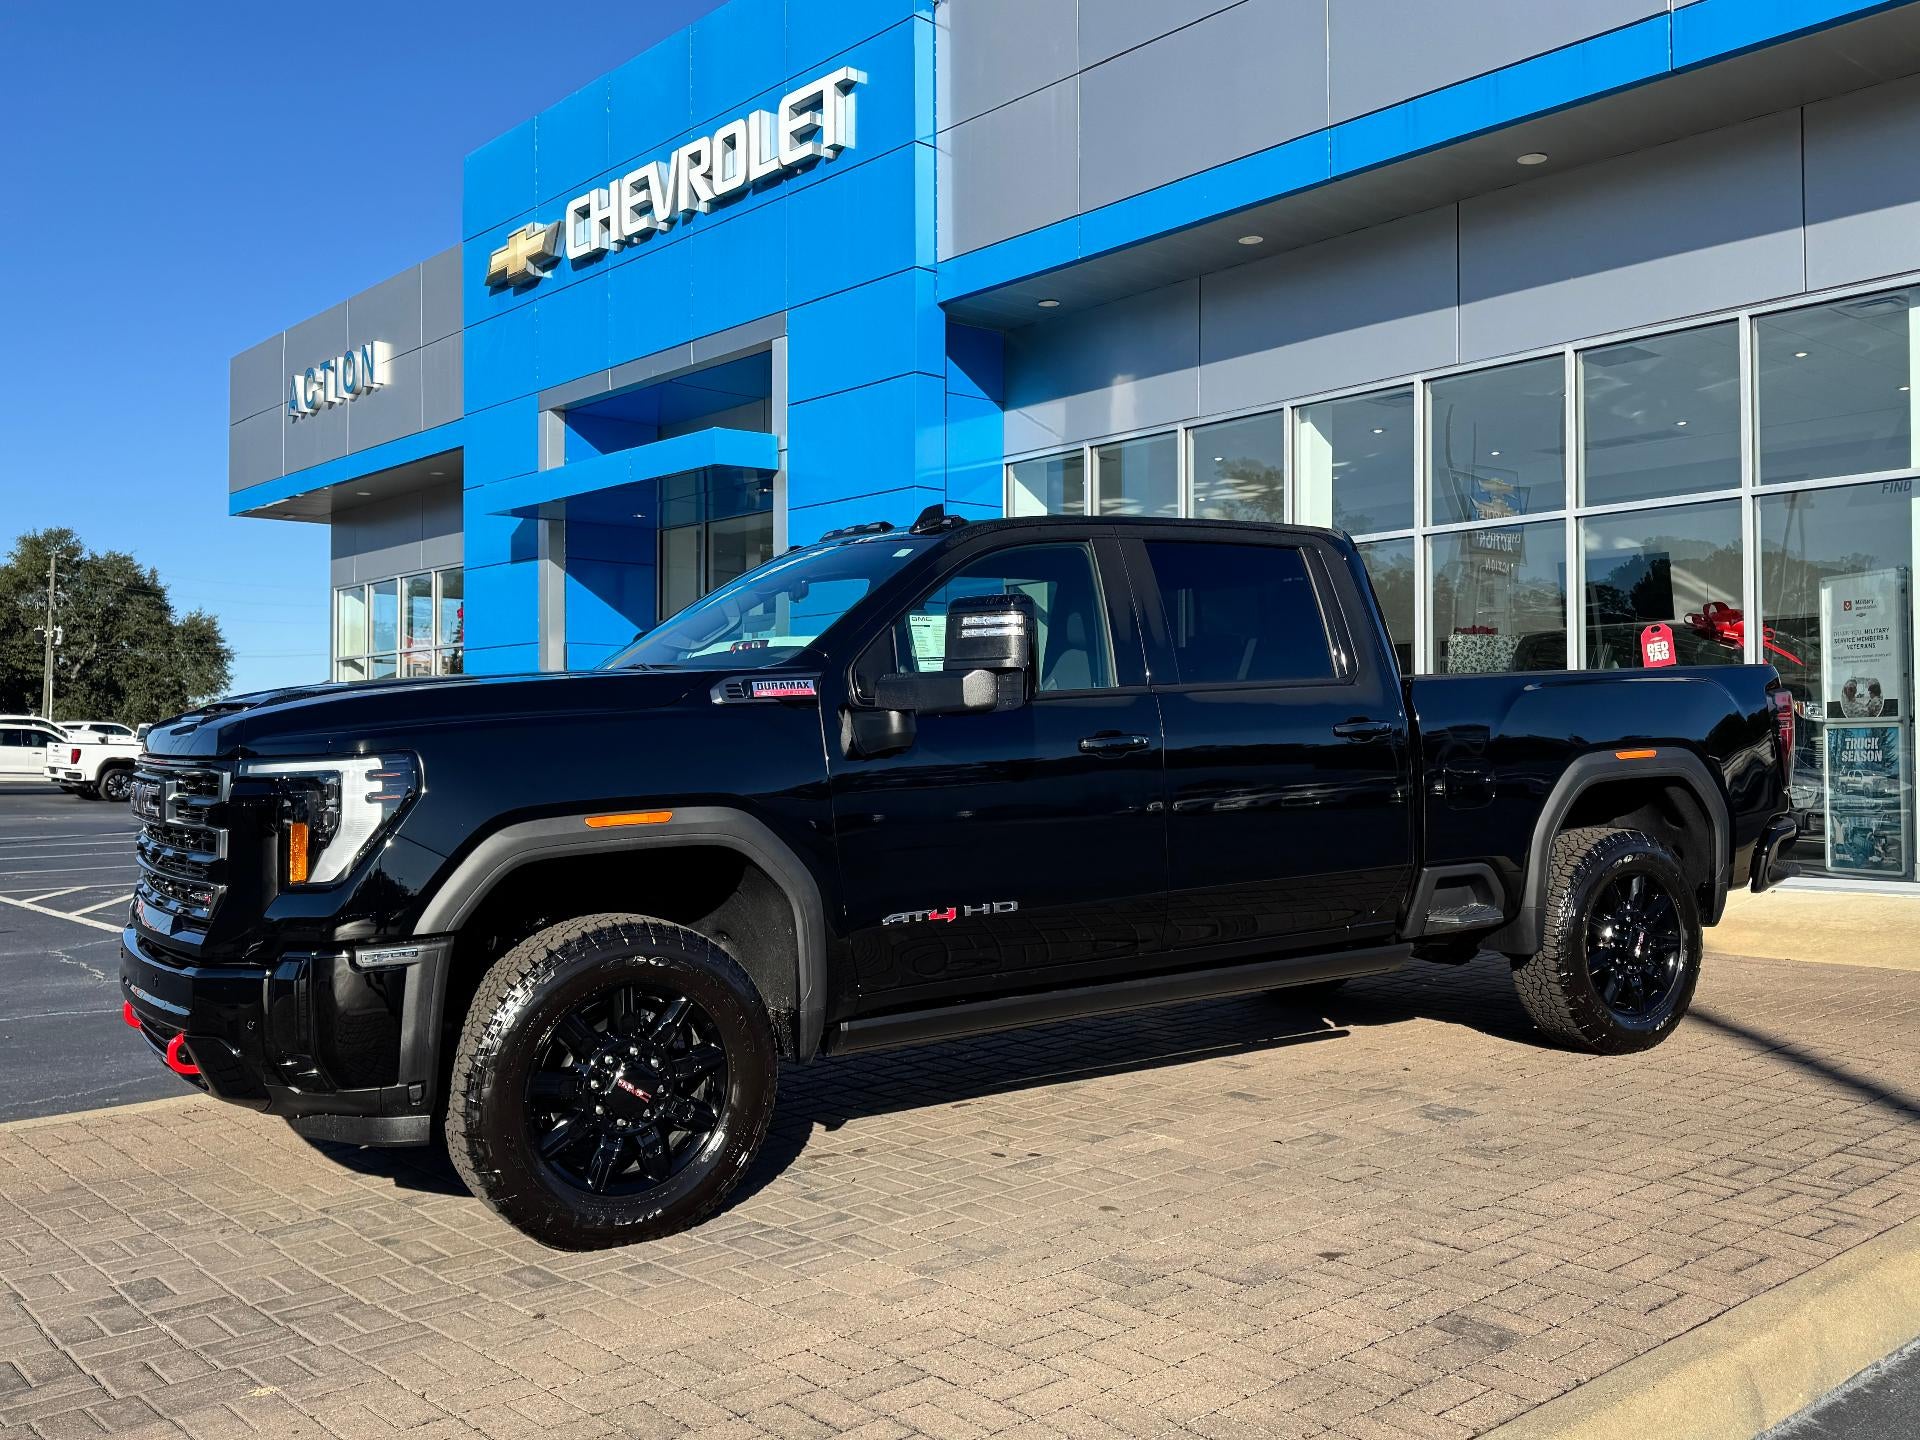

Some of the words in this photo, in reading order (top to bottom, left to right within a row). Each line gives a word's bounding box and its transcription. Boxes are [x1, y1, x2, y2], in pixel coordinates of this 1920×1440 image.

[565, 66, 866, 260] CHEVROLET
[287, 340, 389, 417] ACTION
[1881, 480, 1912, 494] FIND
[1864, 626, 1890, 634] MILITARY
[1856, 635, 1884, 643] MEMBERS
[1646, 641, 1669, 653] RED
[1648, 651, 1670, 662] TAG
[757, 681, 810, 690] DURAMAX
[1844, 737, 1880, 750] TRUCK
[1841, 750, 1883, 762] SEASON
[882, 906, 957, 926] AT4
[963, 900, 1019, 917] HD
